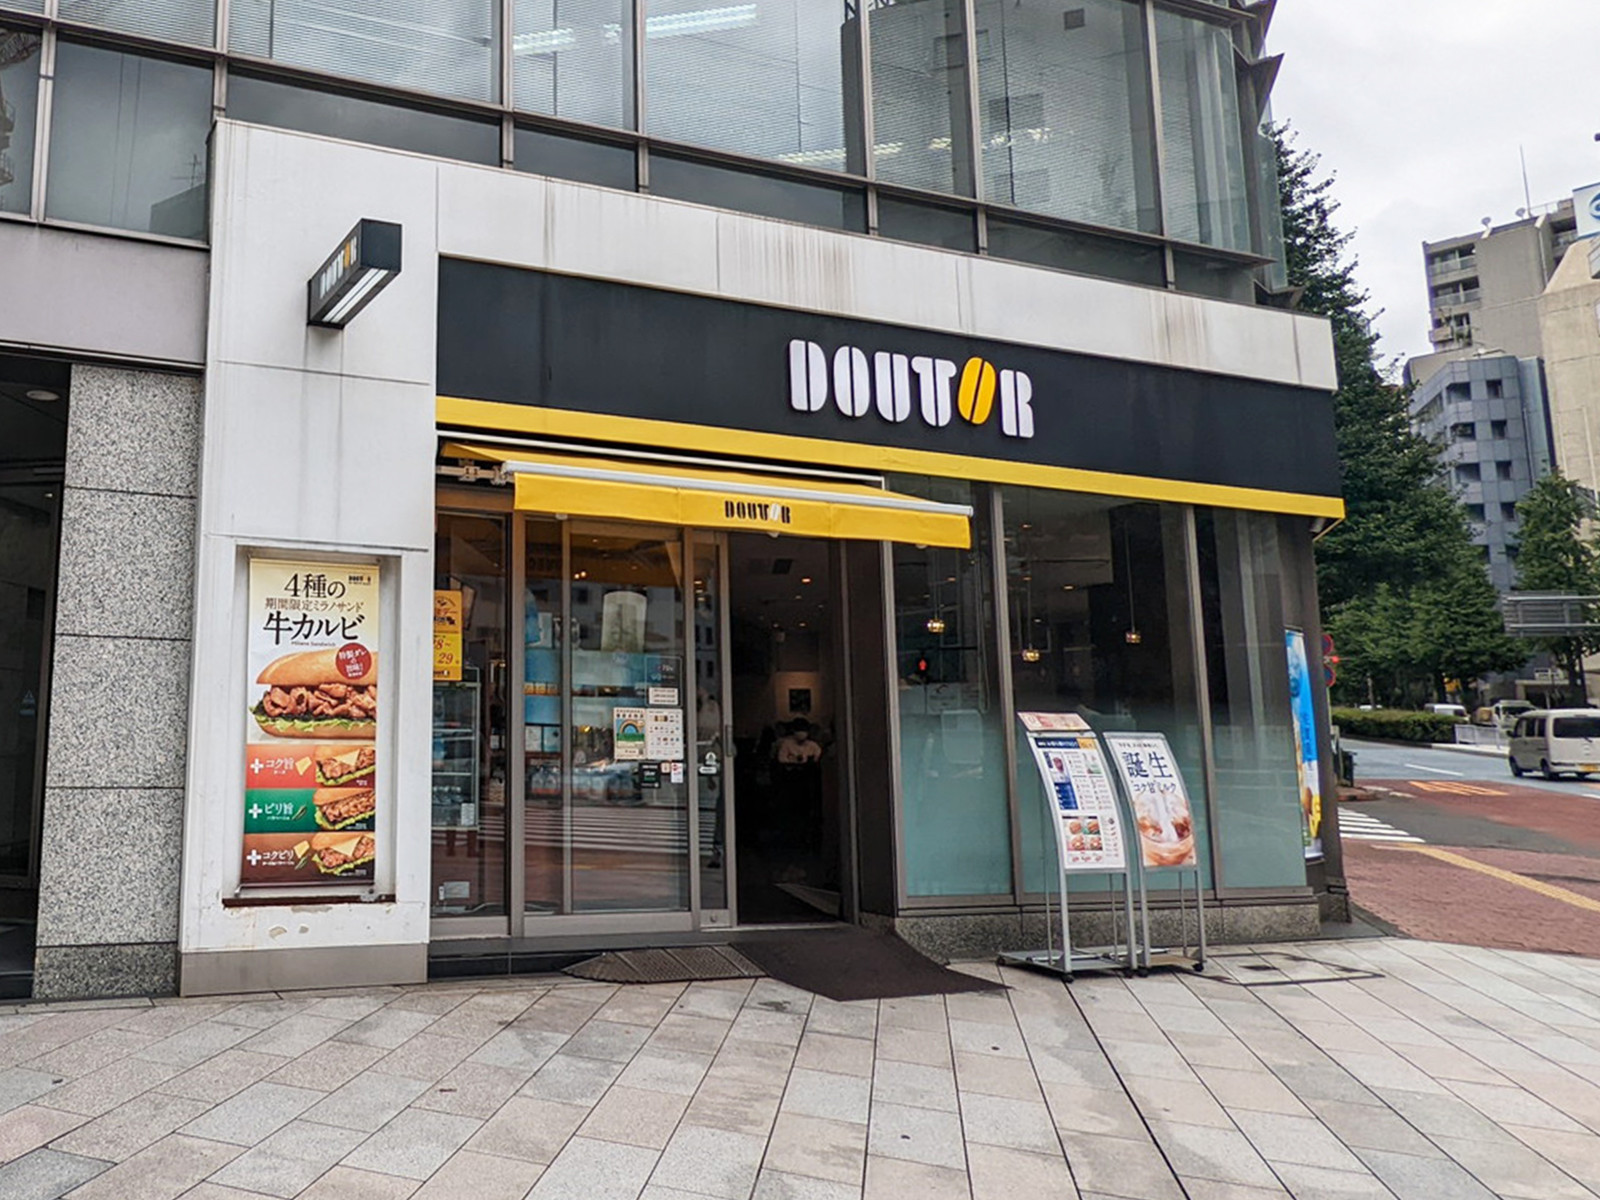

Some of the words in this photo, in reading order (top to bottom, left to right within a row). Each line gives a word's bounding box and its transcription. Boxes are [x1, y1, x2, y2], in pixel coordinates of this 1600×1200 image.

[789, 339, 1034, 438] DOUTOR
[725, 500, 790, 523] DOUTOR
[284, 573, 346, 598] 4種の
[263, 611, 365, 645] 牛カルビ
[1122, 751, 1173, 778] 誕生
